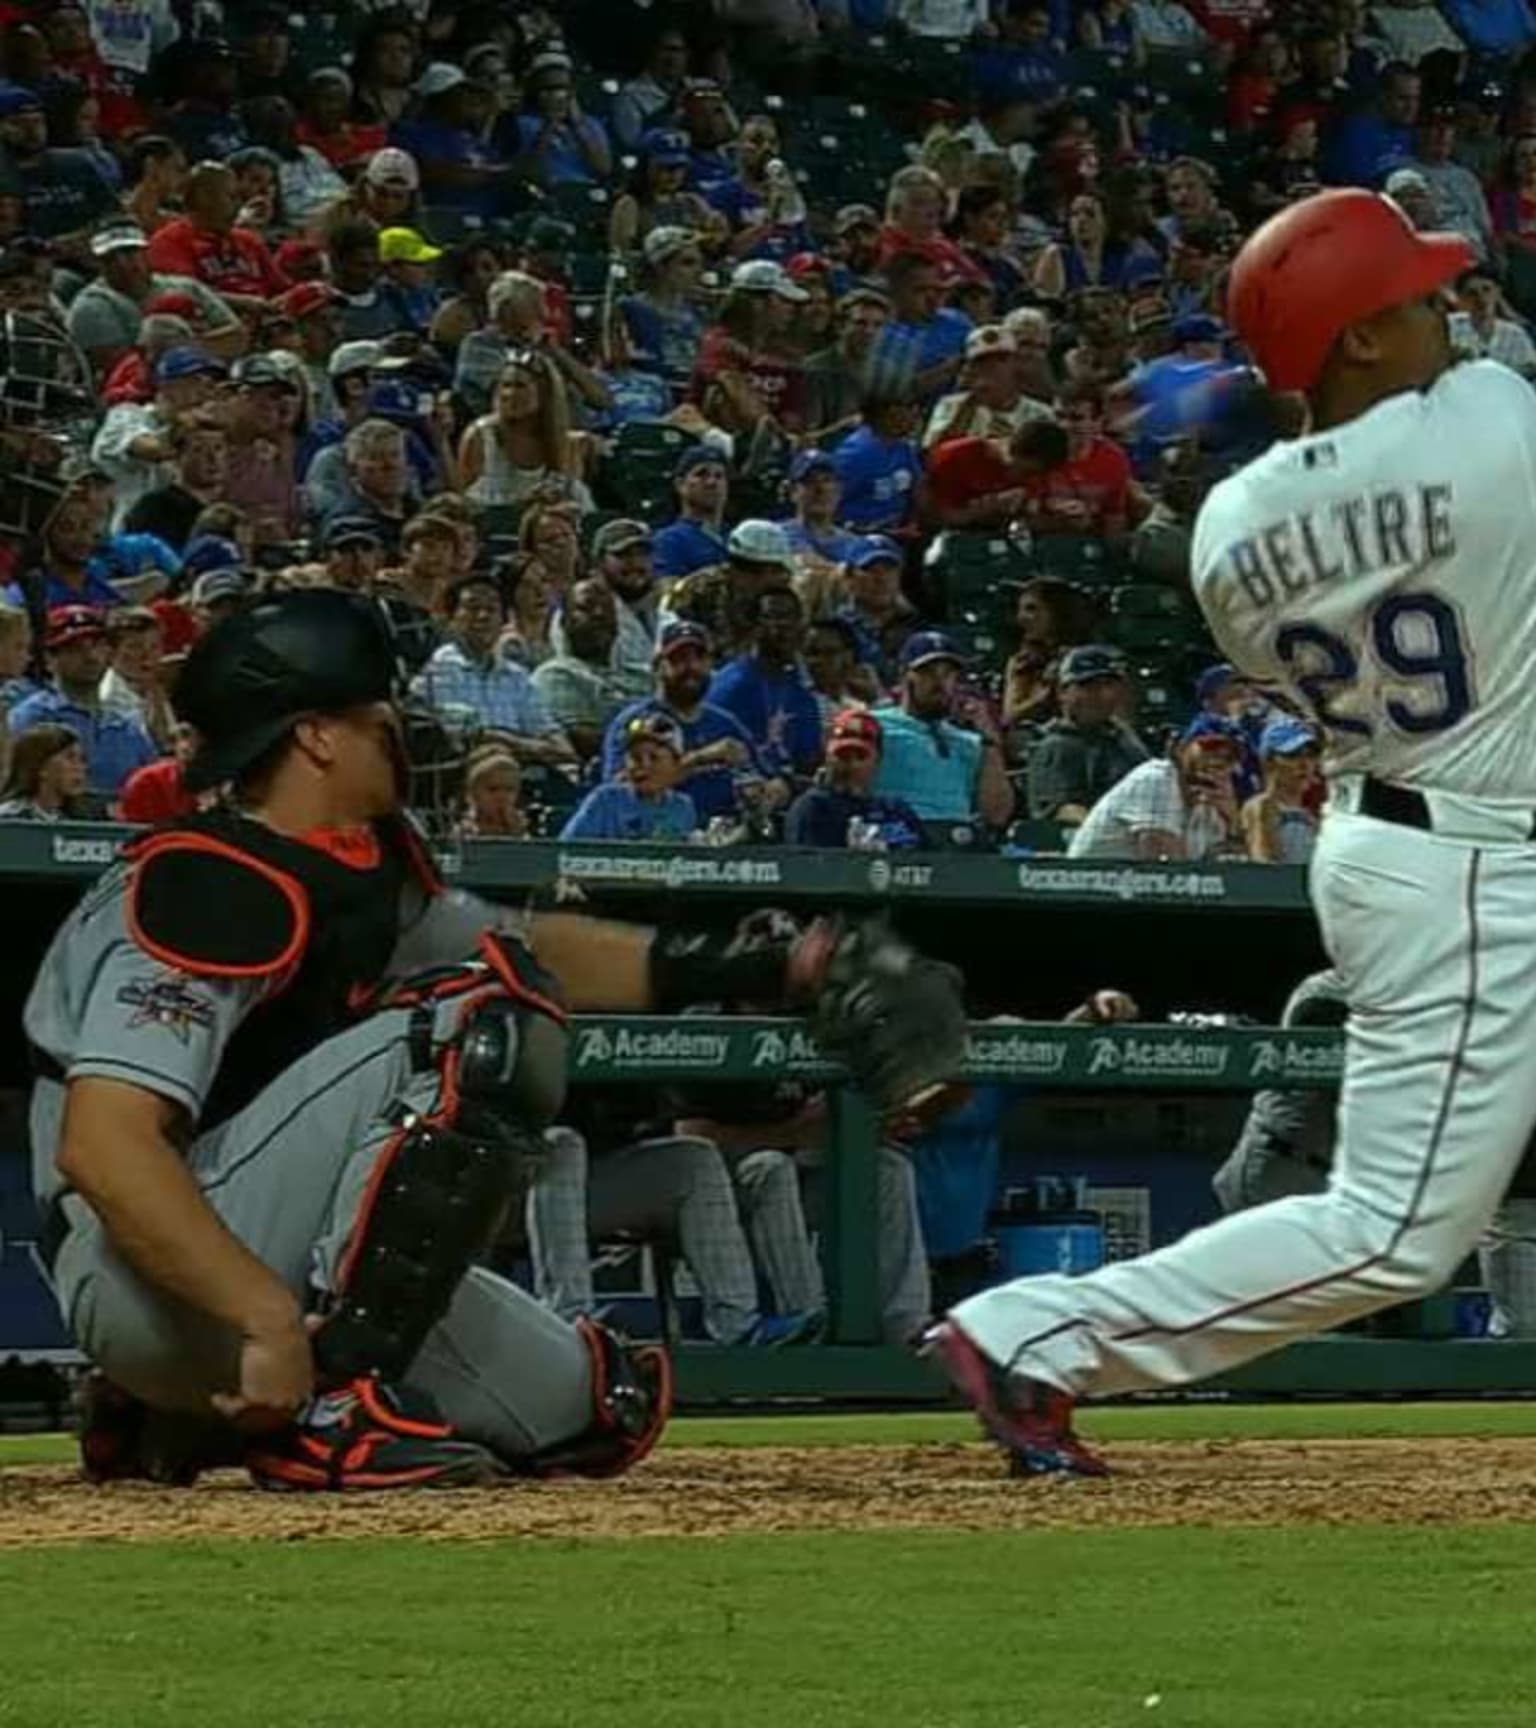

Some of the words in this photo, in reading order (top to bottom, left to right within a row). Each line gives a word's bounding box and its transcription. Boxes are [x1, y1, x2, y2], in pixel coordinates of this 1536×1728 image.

[1228, 481, 1456, 608] BELTRE
[1272, 590, 1475, 740] 29
[558, 855, 780, 885] texasrangers.com
[1019, 865, 1225, 897] texasrangers.com
[615, 1029, 729, 1063] Academy
[1123, 1038, 1229, 1072] Academy
[1284, 1041, 1344, 1067] Acad
